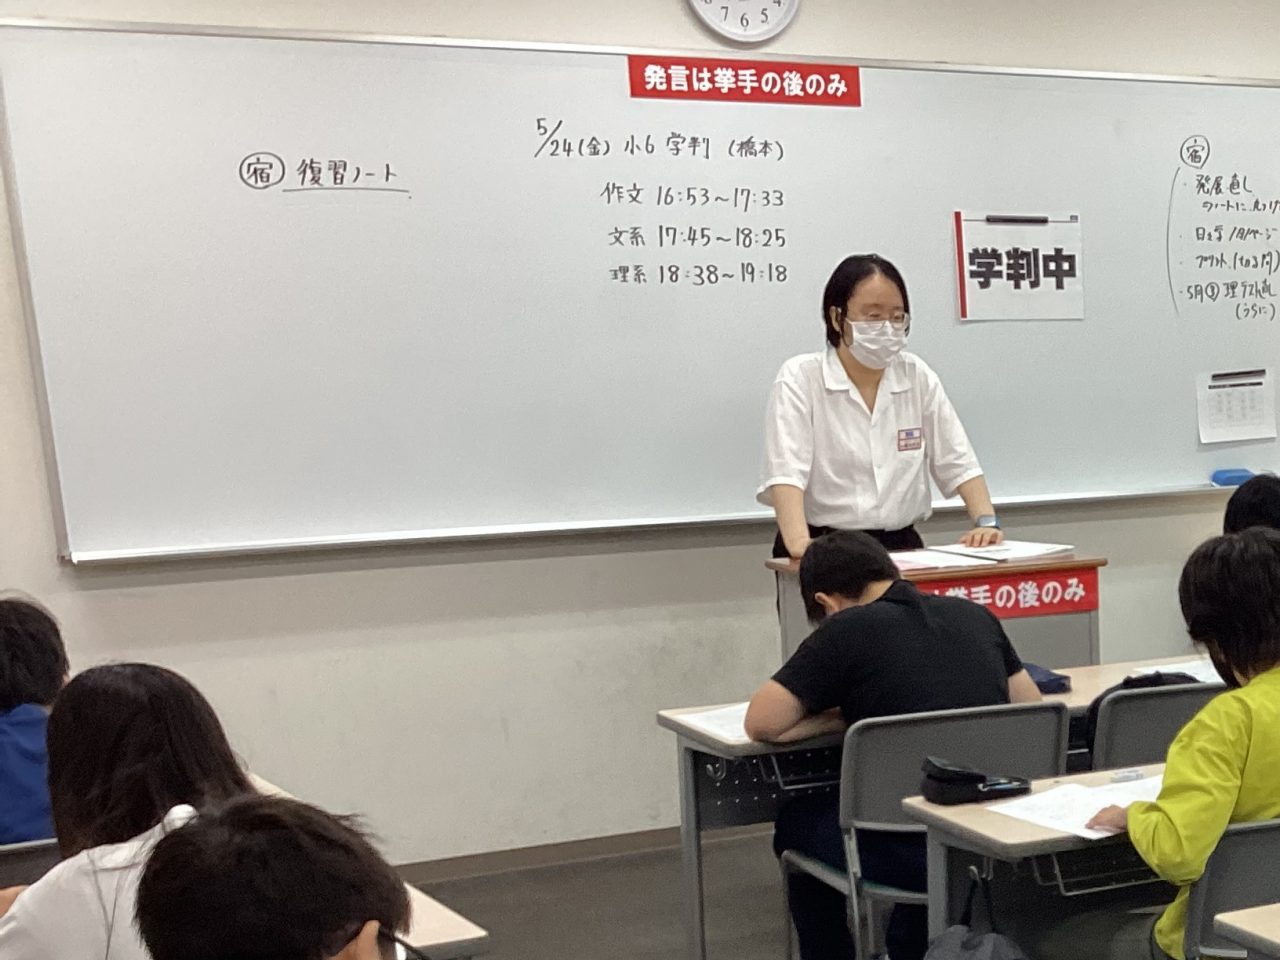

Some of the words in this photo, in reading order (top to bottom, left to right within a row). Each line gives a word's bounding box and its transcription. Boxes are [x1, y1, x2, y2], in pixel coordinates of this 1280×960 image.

[720, 6, 729, 22] 7
[740, 13, 750, 28] 6
[760, 8, 769, 24] 5
[644, 63, 848, 98] 発言は挙手の後のみ
[296, 158, 398, 187] 復習ノート
[600, 182, 645, 206] 作文
[608, 227, 646, 247] 文系
[609, 264, 648, 285] 理系
[968, 247, 1077, 290] 学判中
